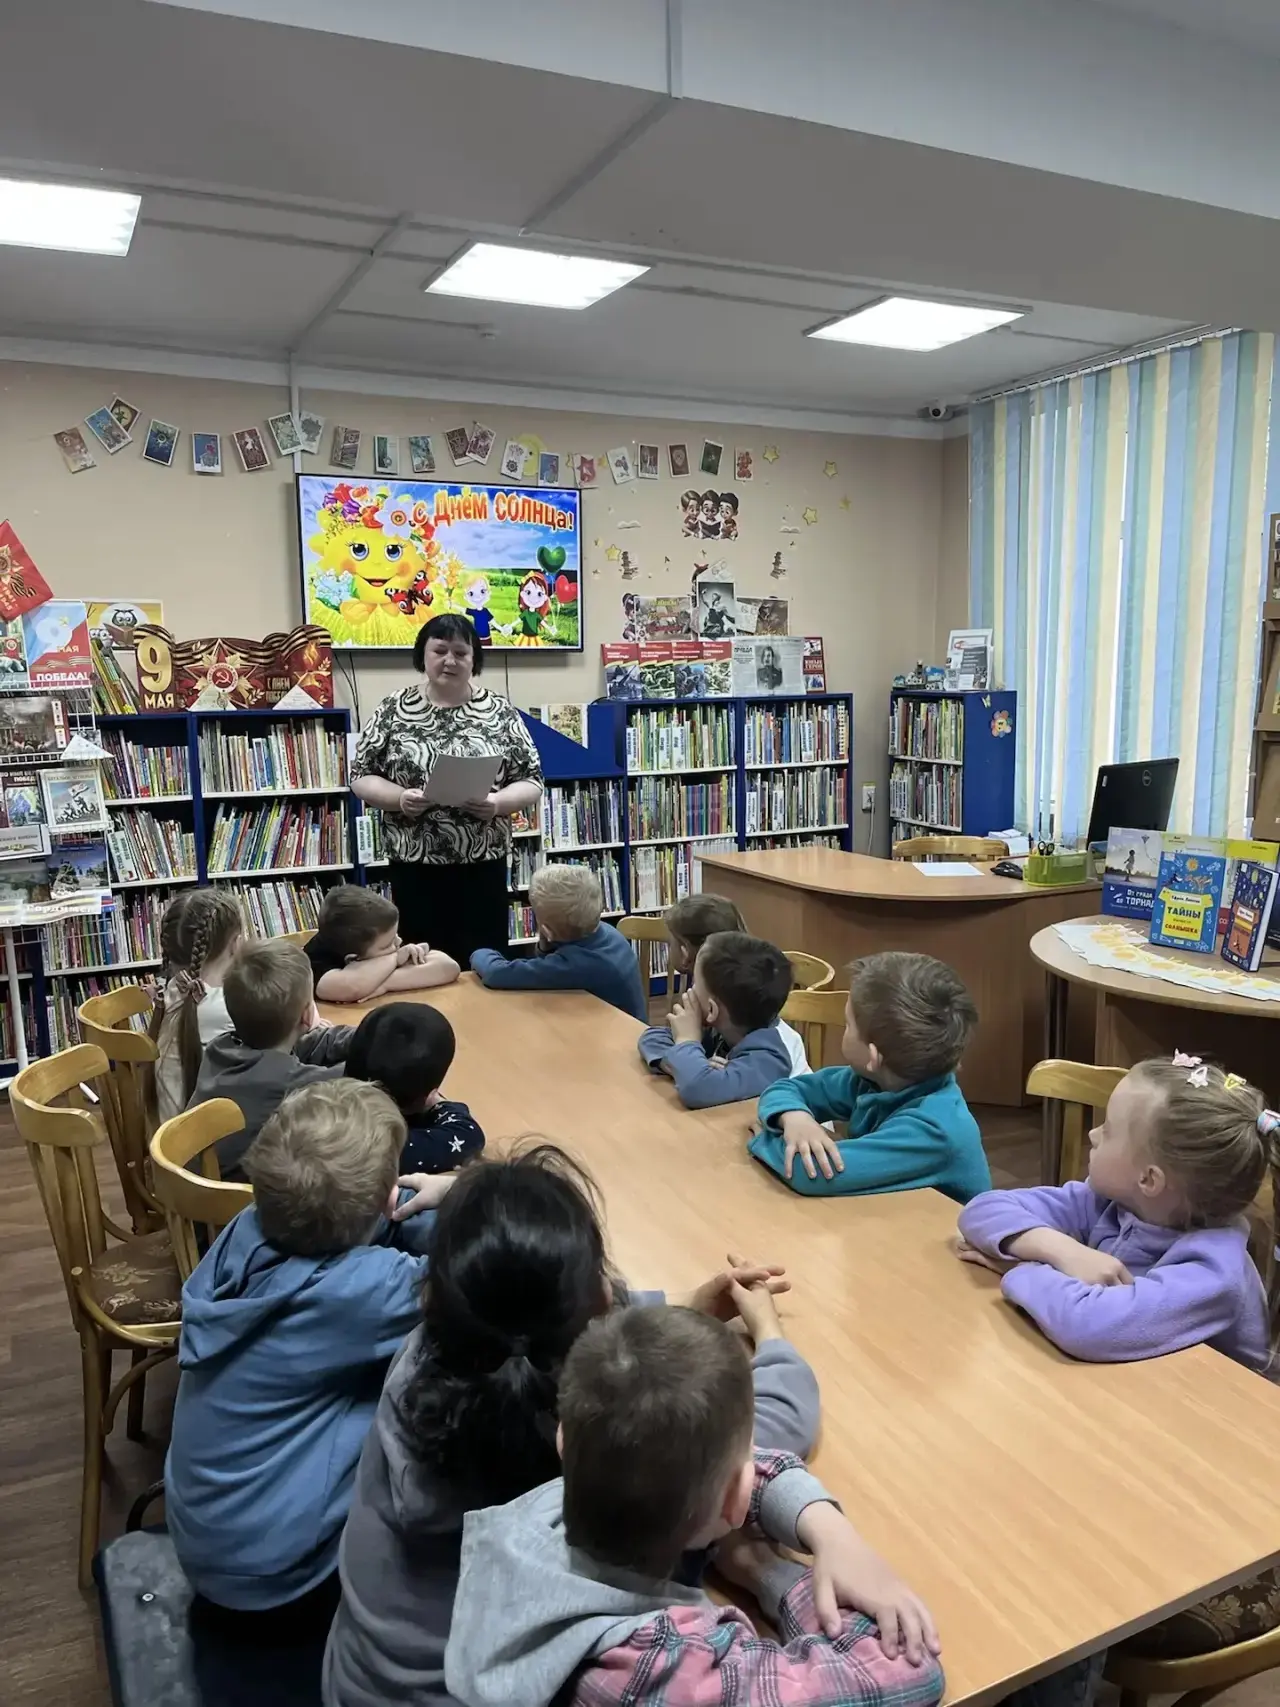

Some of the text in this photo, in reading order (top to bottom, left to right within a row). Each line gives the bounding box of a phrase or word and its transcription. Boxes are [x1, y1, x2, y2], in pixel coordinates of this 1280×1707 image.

[57, 645, 80, 653] МАЯ
[137, 636, 172, 692] 9
[36, 671, 88, 682] ПОБЕДА!
[144, 693, 175, 709] МАЯ
[1167, 906, 1201, 919] ТАЙНЫ
[1165, 923, 1198, 934] СОЛНЫШКА
